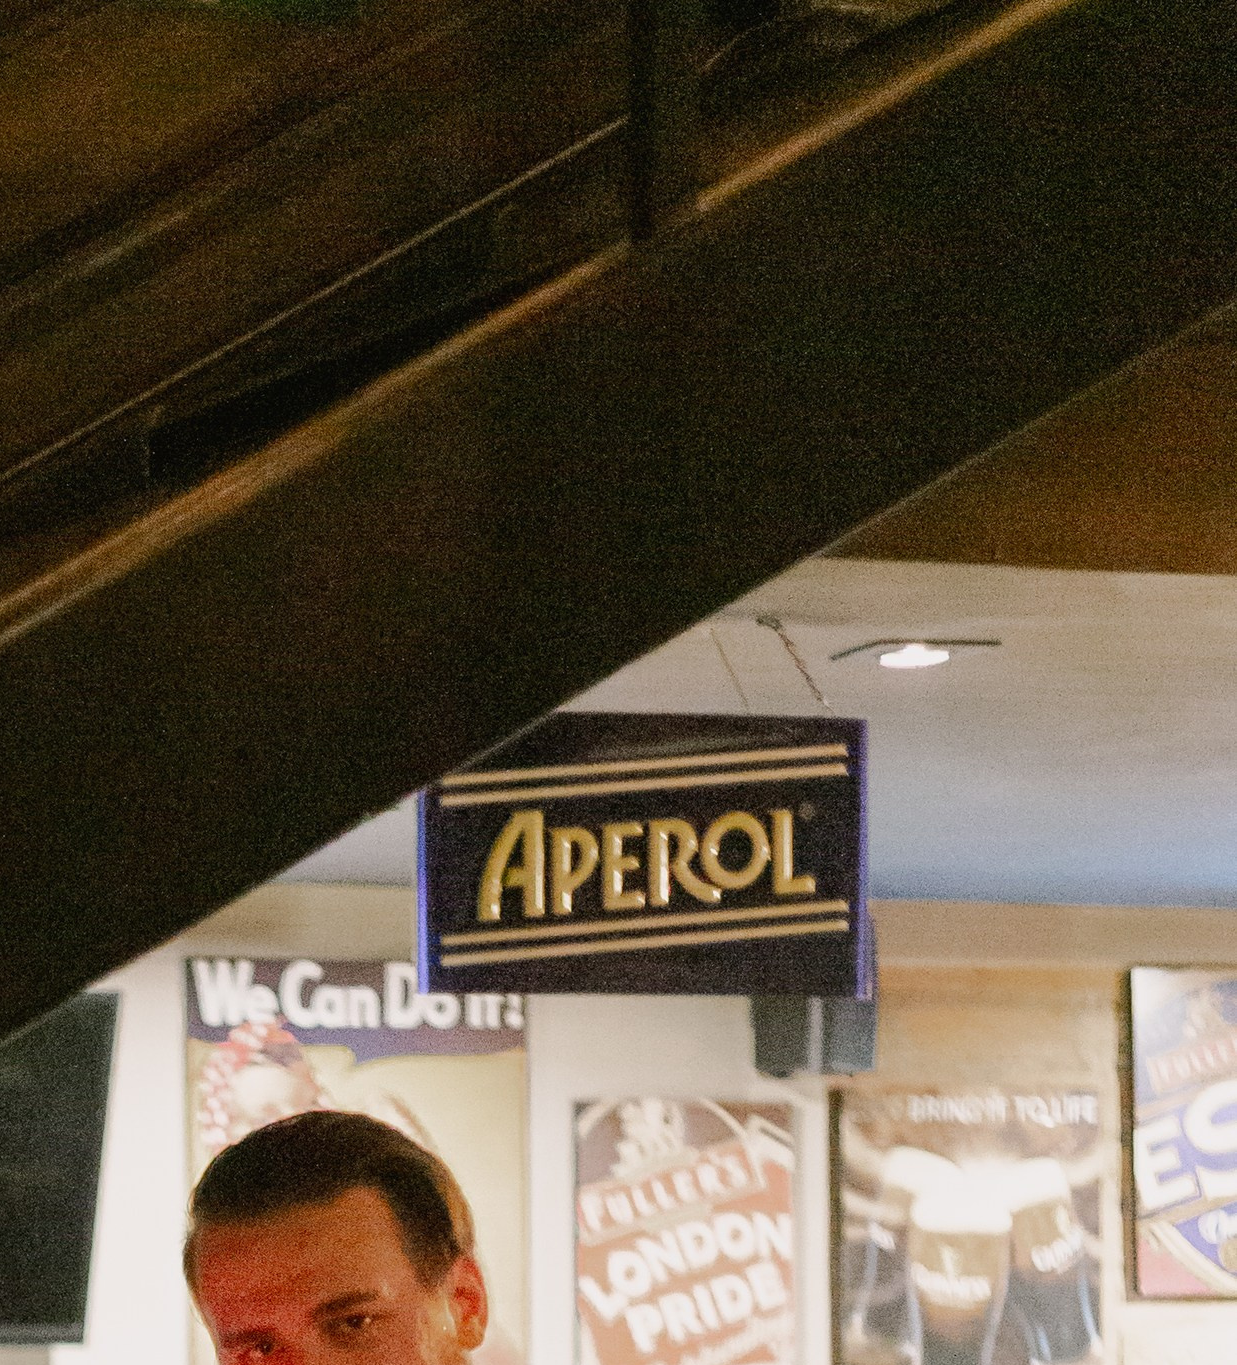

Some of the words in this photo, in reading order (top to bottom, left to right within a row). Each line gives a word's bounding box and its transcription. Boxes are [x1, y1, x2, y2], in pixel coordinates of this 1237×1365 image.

[478, 810, 817, 921] APEROL
[194, 958, 279, 1028] We
[279, 958, 381, 1029] Can
[383, 961, 461, 1030] Do
[578, 1209, 792, 1322] LONDON
[625, 1259, 788, 1354] PRIDE
